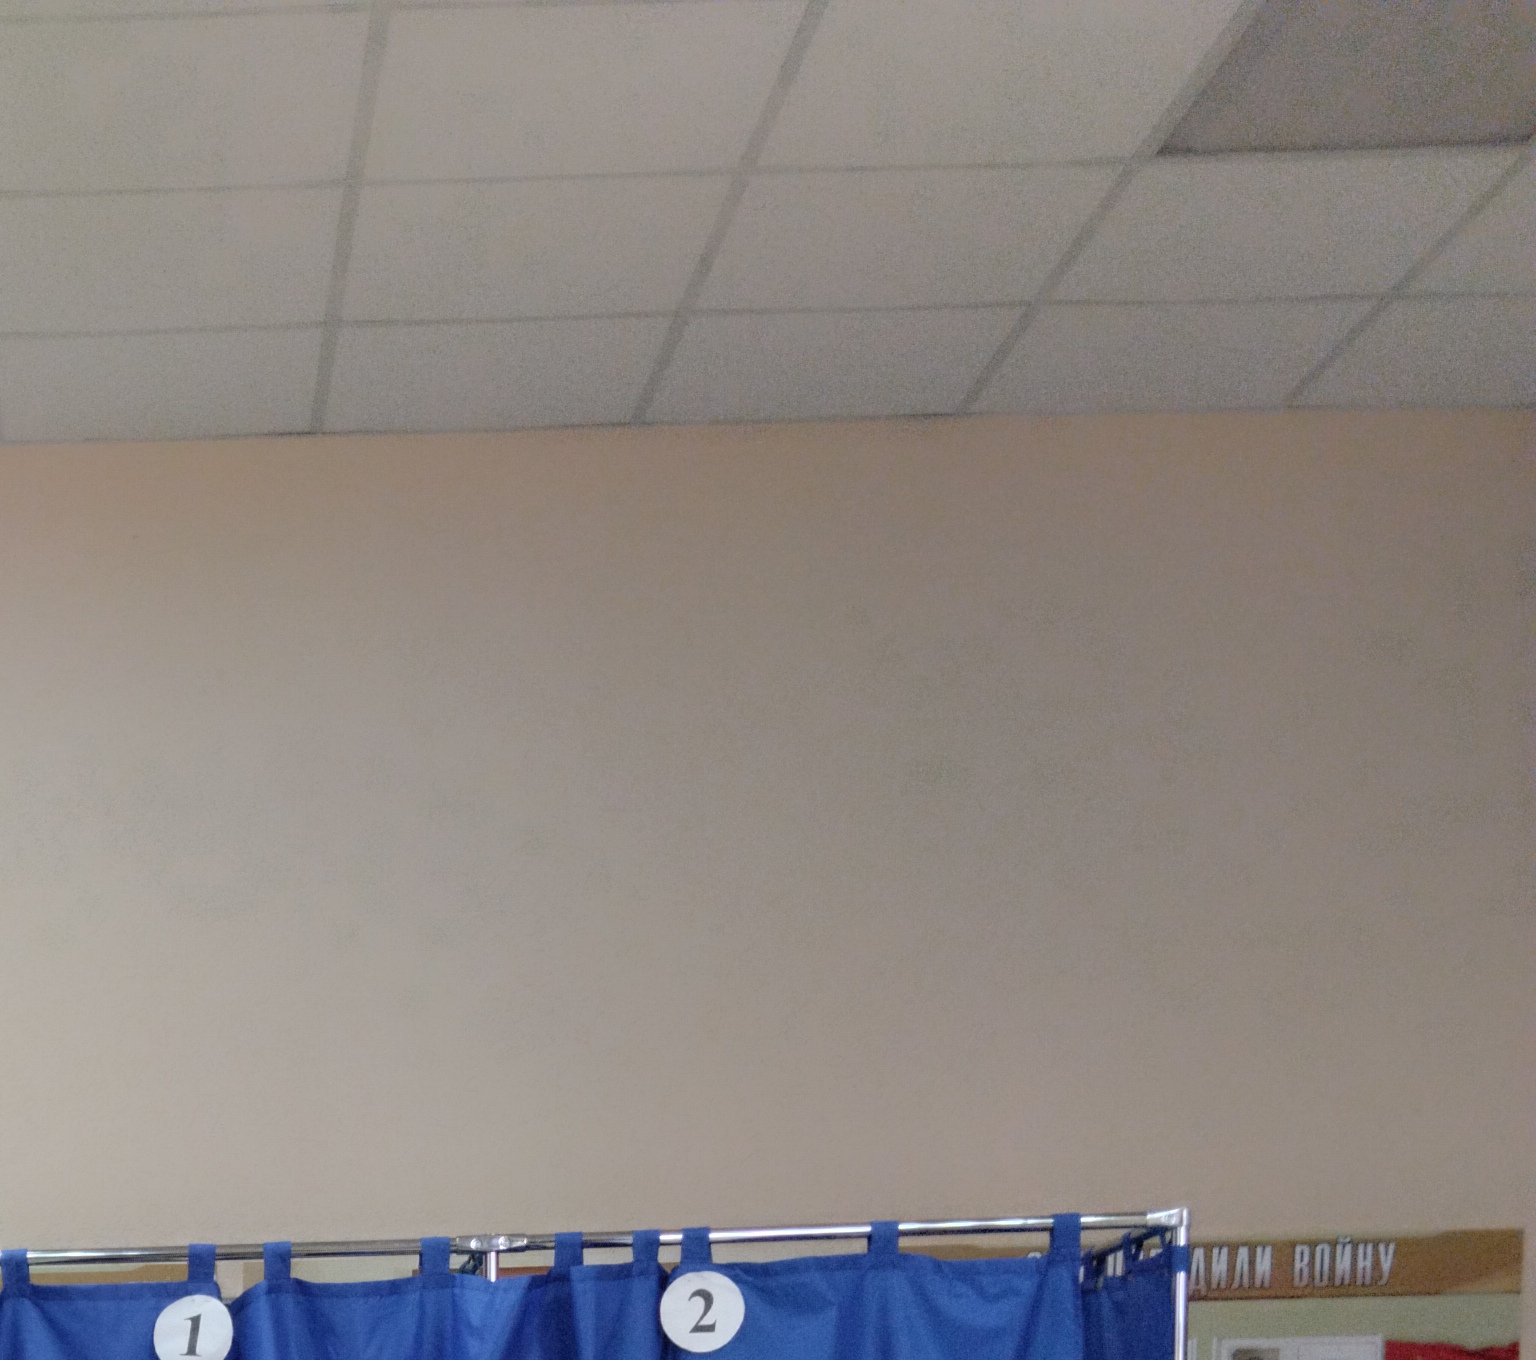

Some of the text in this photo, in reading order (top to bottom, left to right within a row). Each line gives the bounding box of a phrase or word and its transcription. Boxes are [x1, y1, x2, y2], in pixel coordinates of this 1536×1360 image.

[1292, 1235, 1396, 1288] ВОЙНУ
[688, 1288, 717, 1334] 2
[179, 1313, 202, 1357] 1
